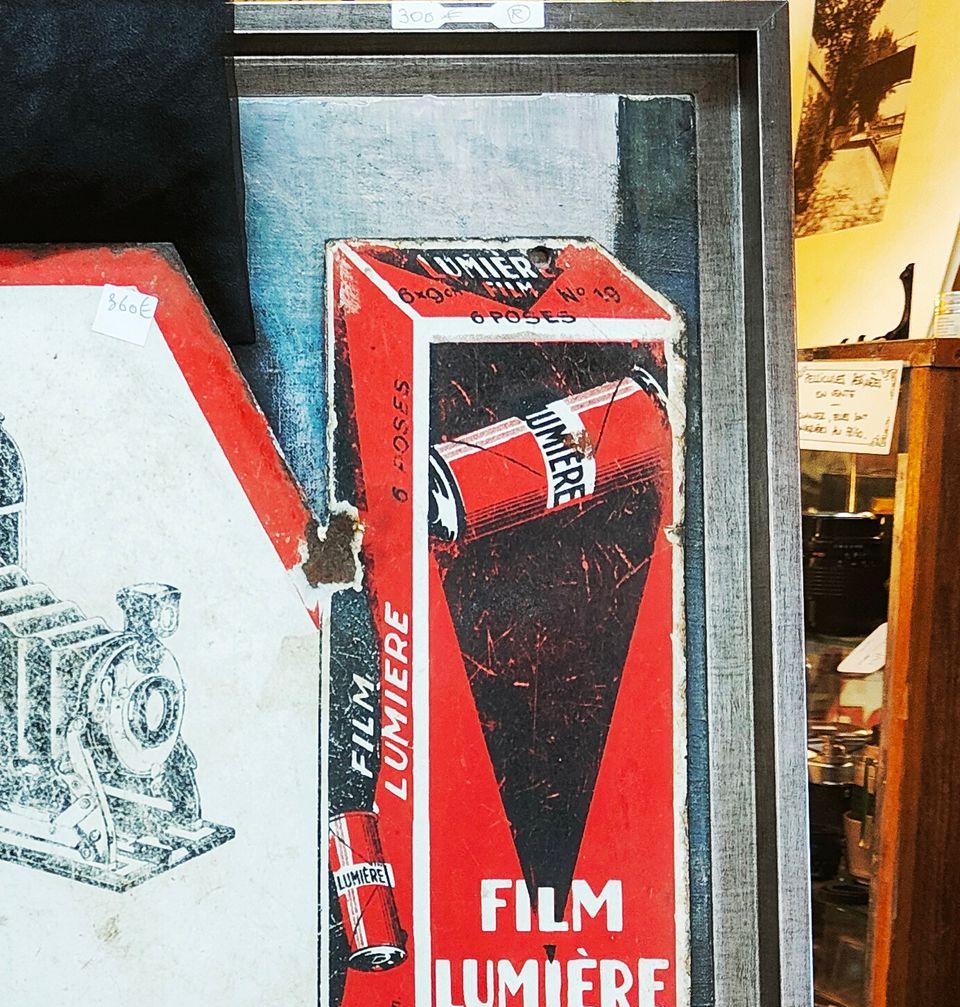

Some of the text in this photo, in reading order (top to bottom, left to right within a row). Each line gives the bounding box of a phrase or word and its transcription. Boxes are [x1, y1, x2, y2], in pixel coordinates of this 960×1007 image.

[483, 280, 538, 298] FILM
[470, 310, 576, 325] 6 POSES
[351, 673, 374, 778] FILM
[381, 601, 409, 801] LUMIERE
[480, 879, 623, 932] FILM
